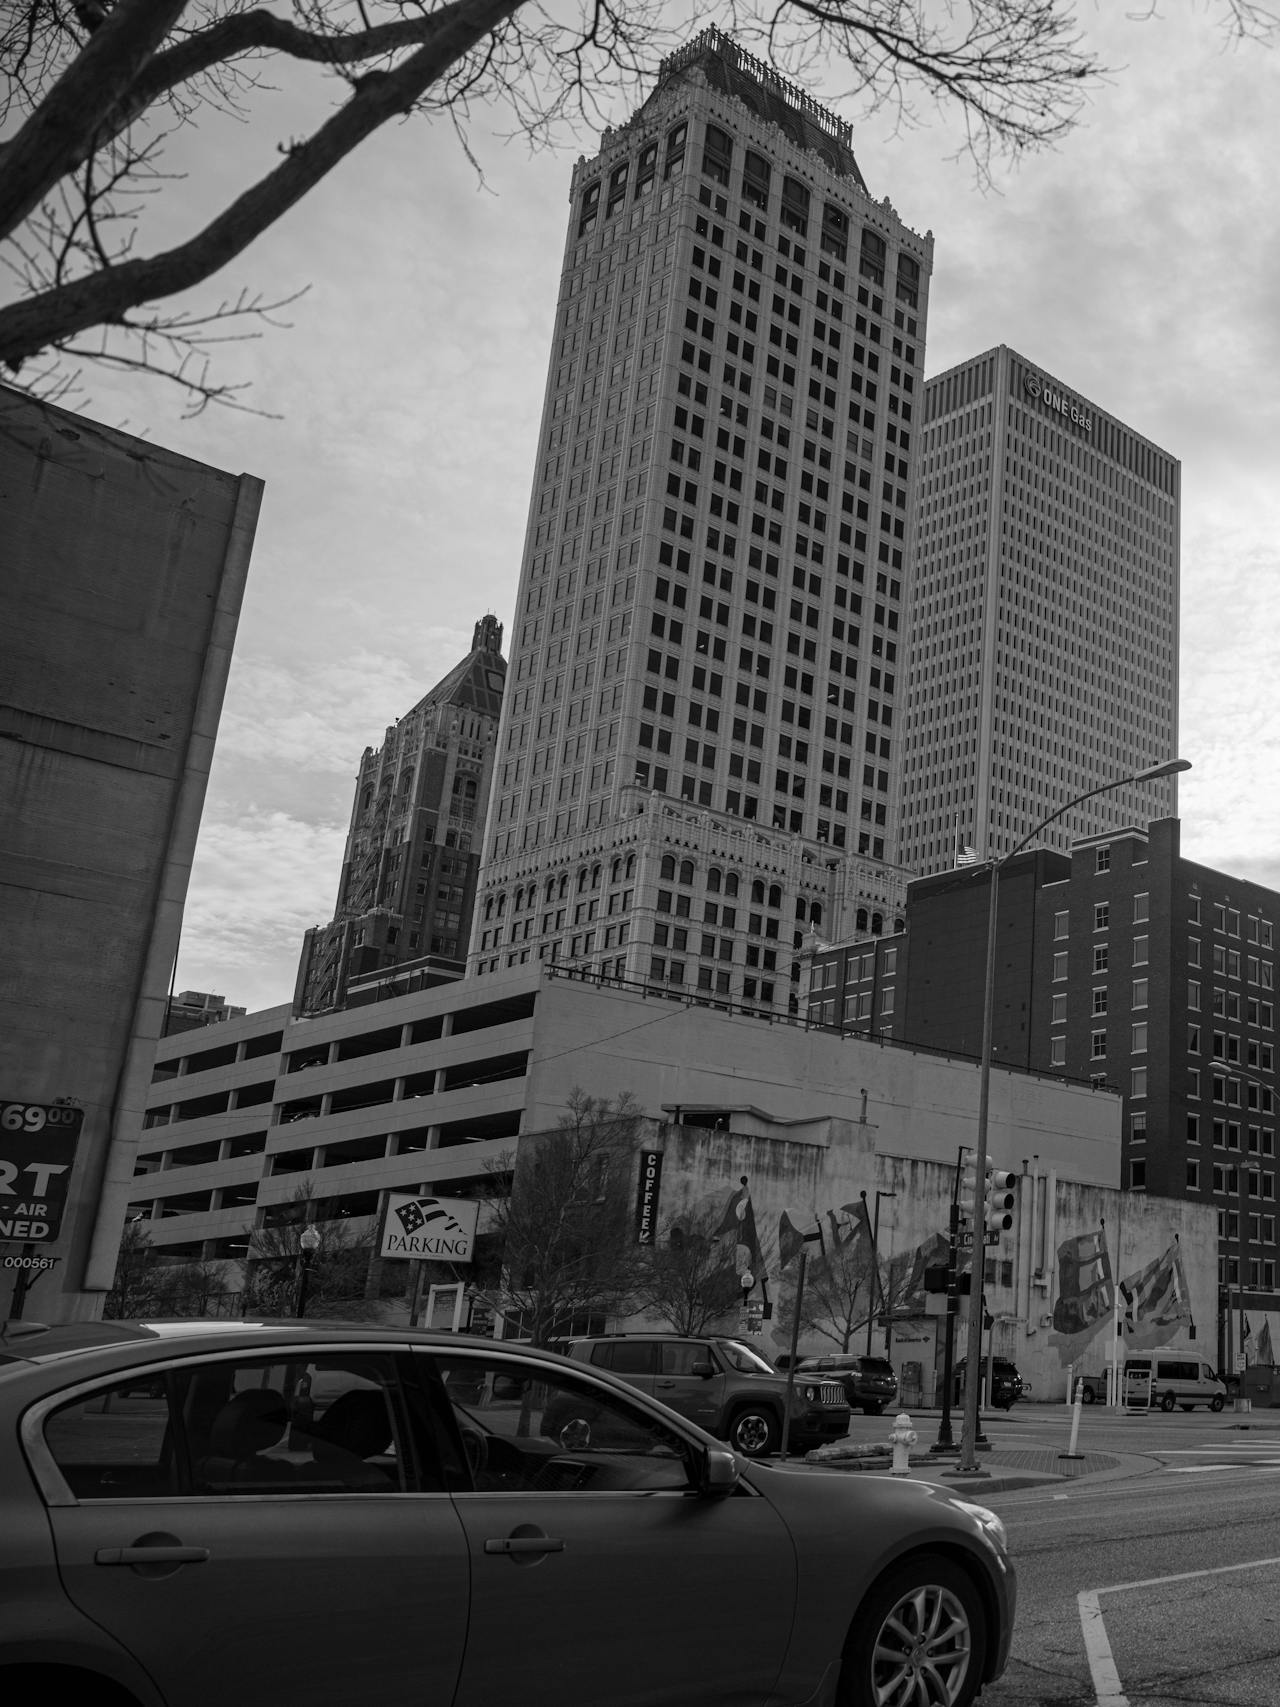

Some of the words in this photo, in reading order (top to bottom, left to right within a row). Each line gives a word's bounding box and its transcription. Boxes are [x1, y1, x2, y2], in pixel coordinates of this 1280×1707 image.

[1043, 388, 1069, 417] ONE
[1070, 406, 1092, 432] Gas
[641, 1154, 657, 1230] COFFEE
[13, 1203, 48, 1217] AIR
[387, 1234, 468, 1255] PARKING
[4, 1256, 55, 1270] 000561
